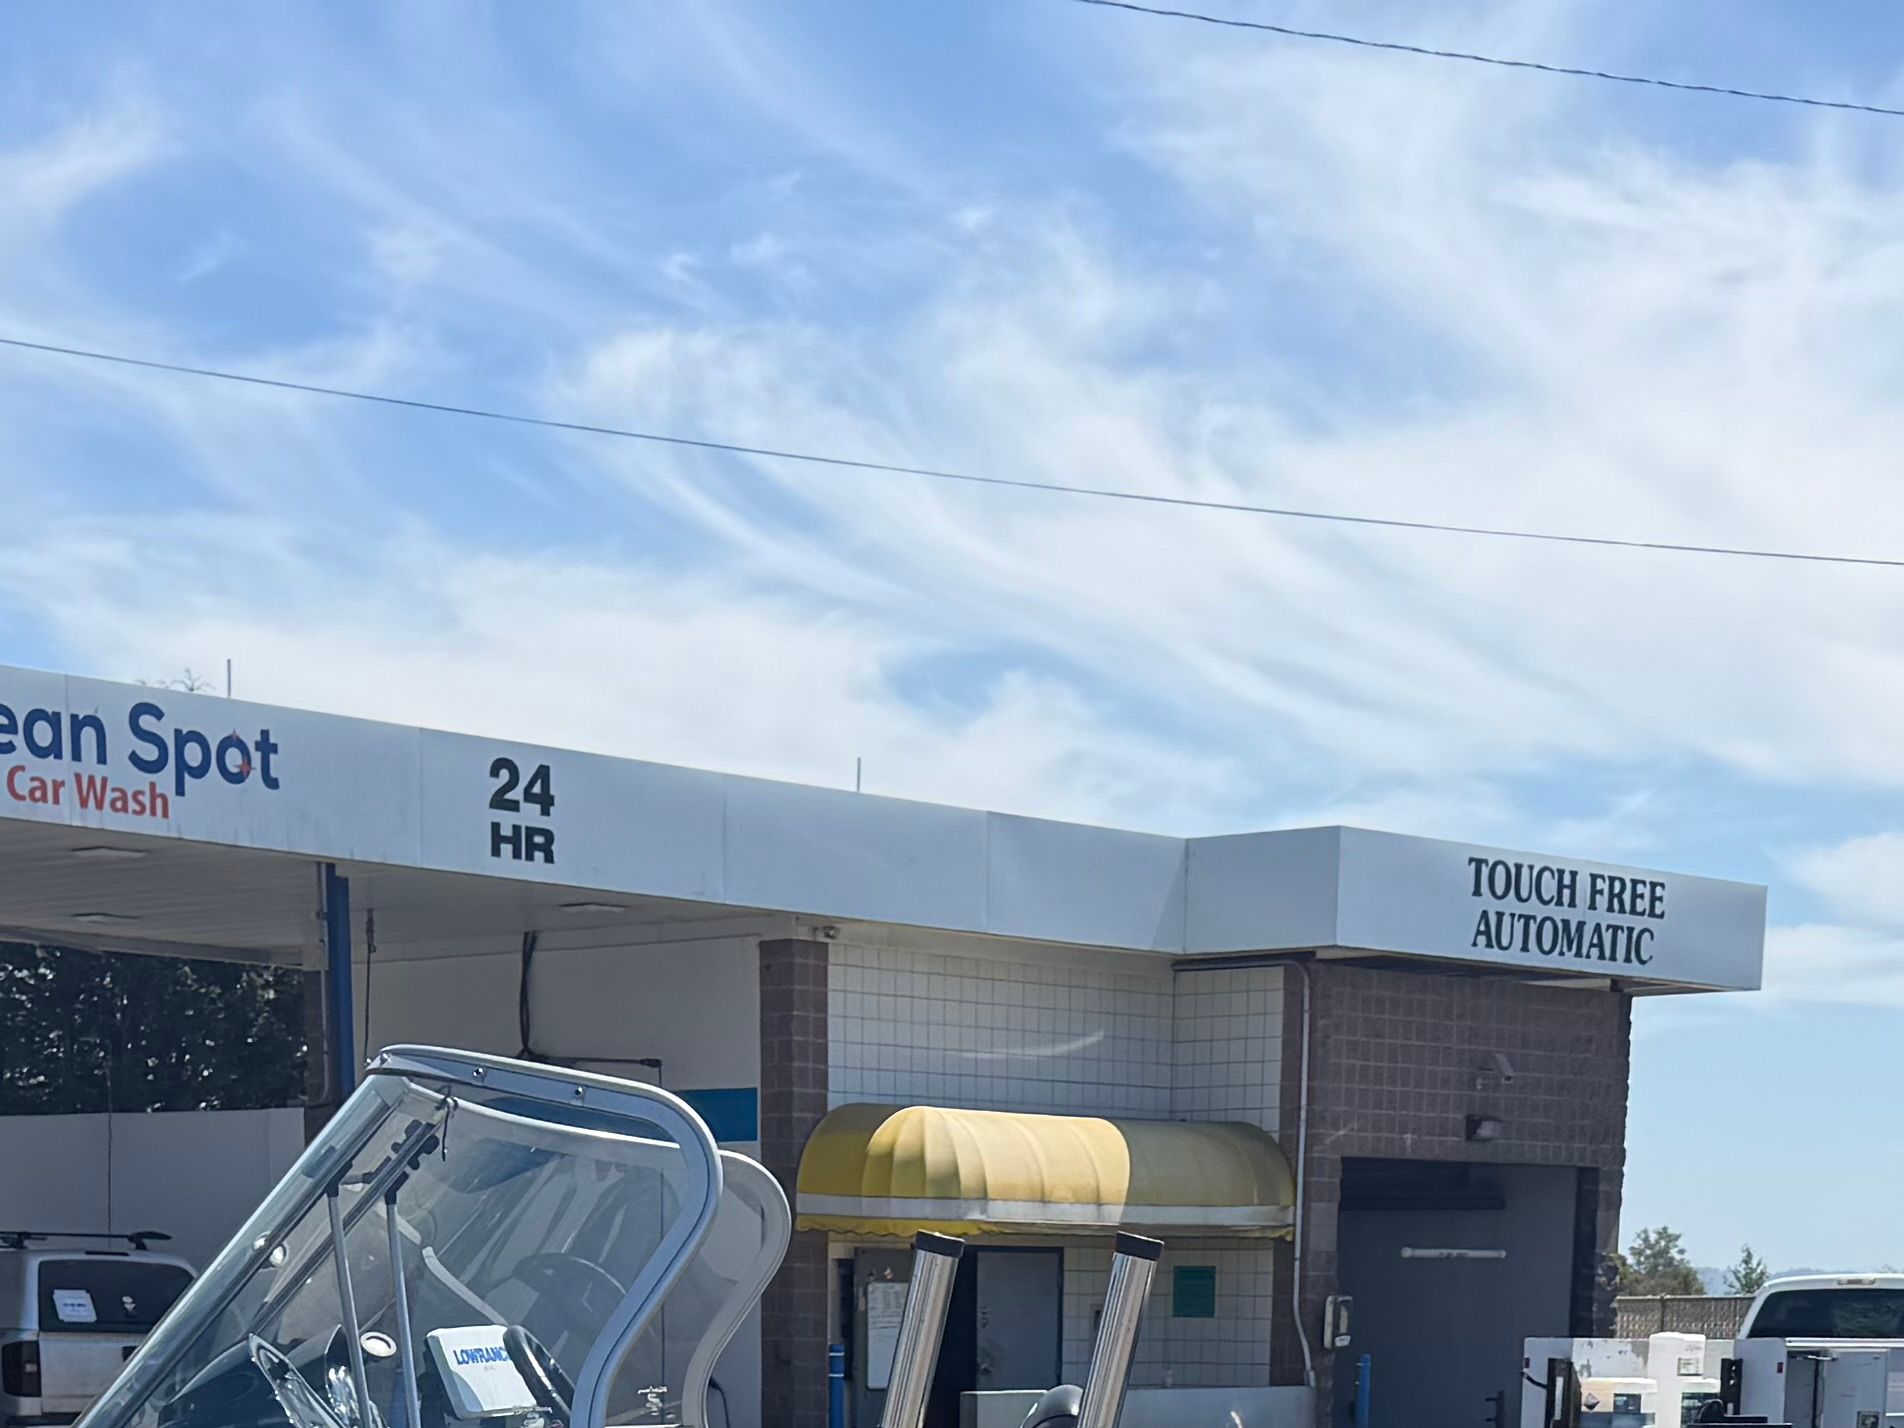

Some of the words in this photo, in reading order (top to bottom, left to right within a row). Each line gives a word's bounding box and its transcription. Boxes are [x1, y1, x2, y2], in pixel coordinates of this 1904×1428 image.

[127, 701, 280, 797] Spot
[6, 764, 66, 807] Car
[73, 771, 170, 820] Wash
[488, 757, 555, 817] 24
[490, 820, 555, 865] HR
[1467, 856, 1579, 909] TOUCH
[1587, 872, 1666, 920] FREE
[1470, 909, 1655, 966] AUTOMATIC
[452, 1346, 511, 1366] LOWRANC
